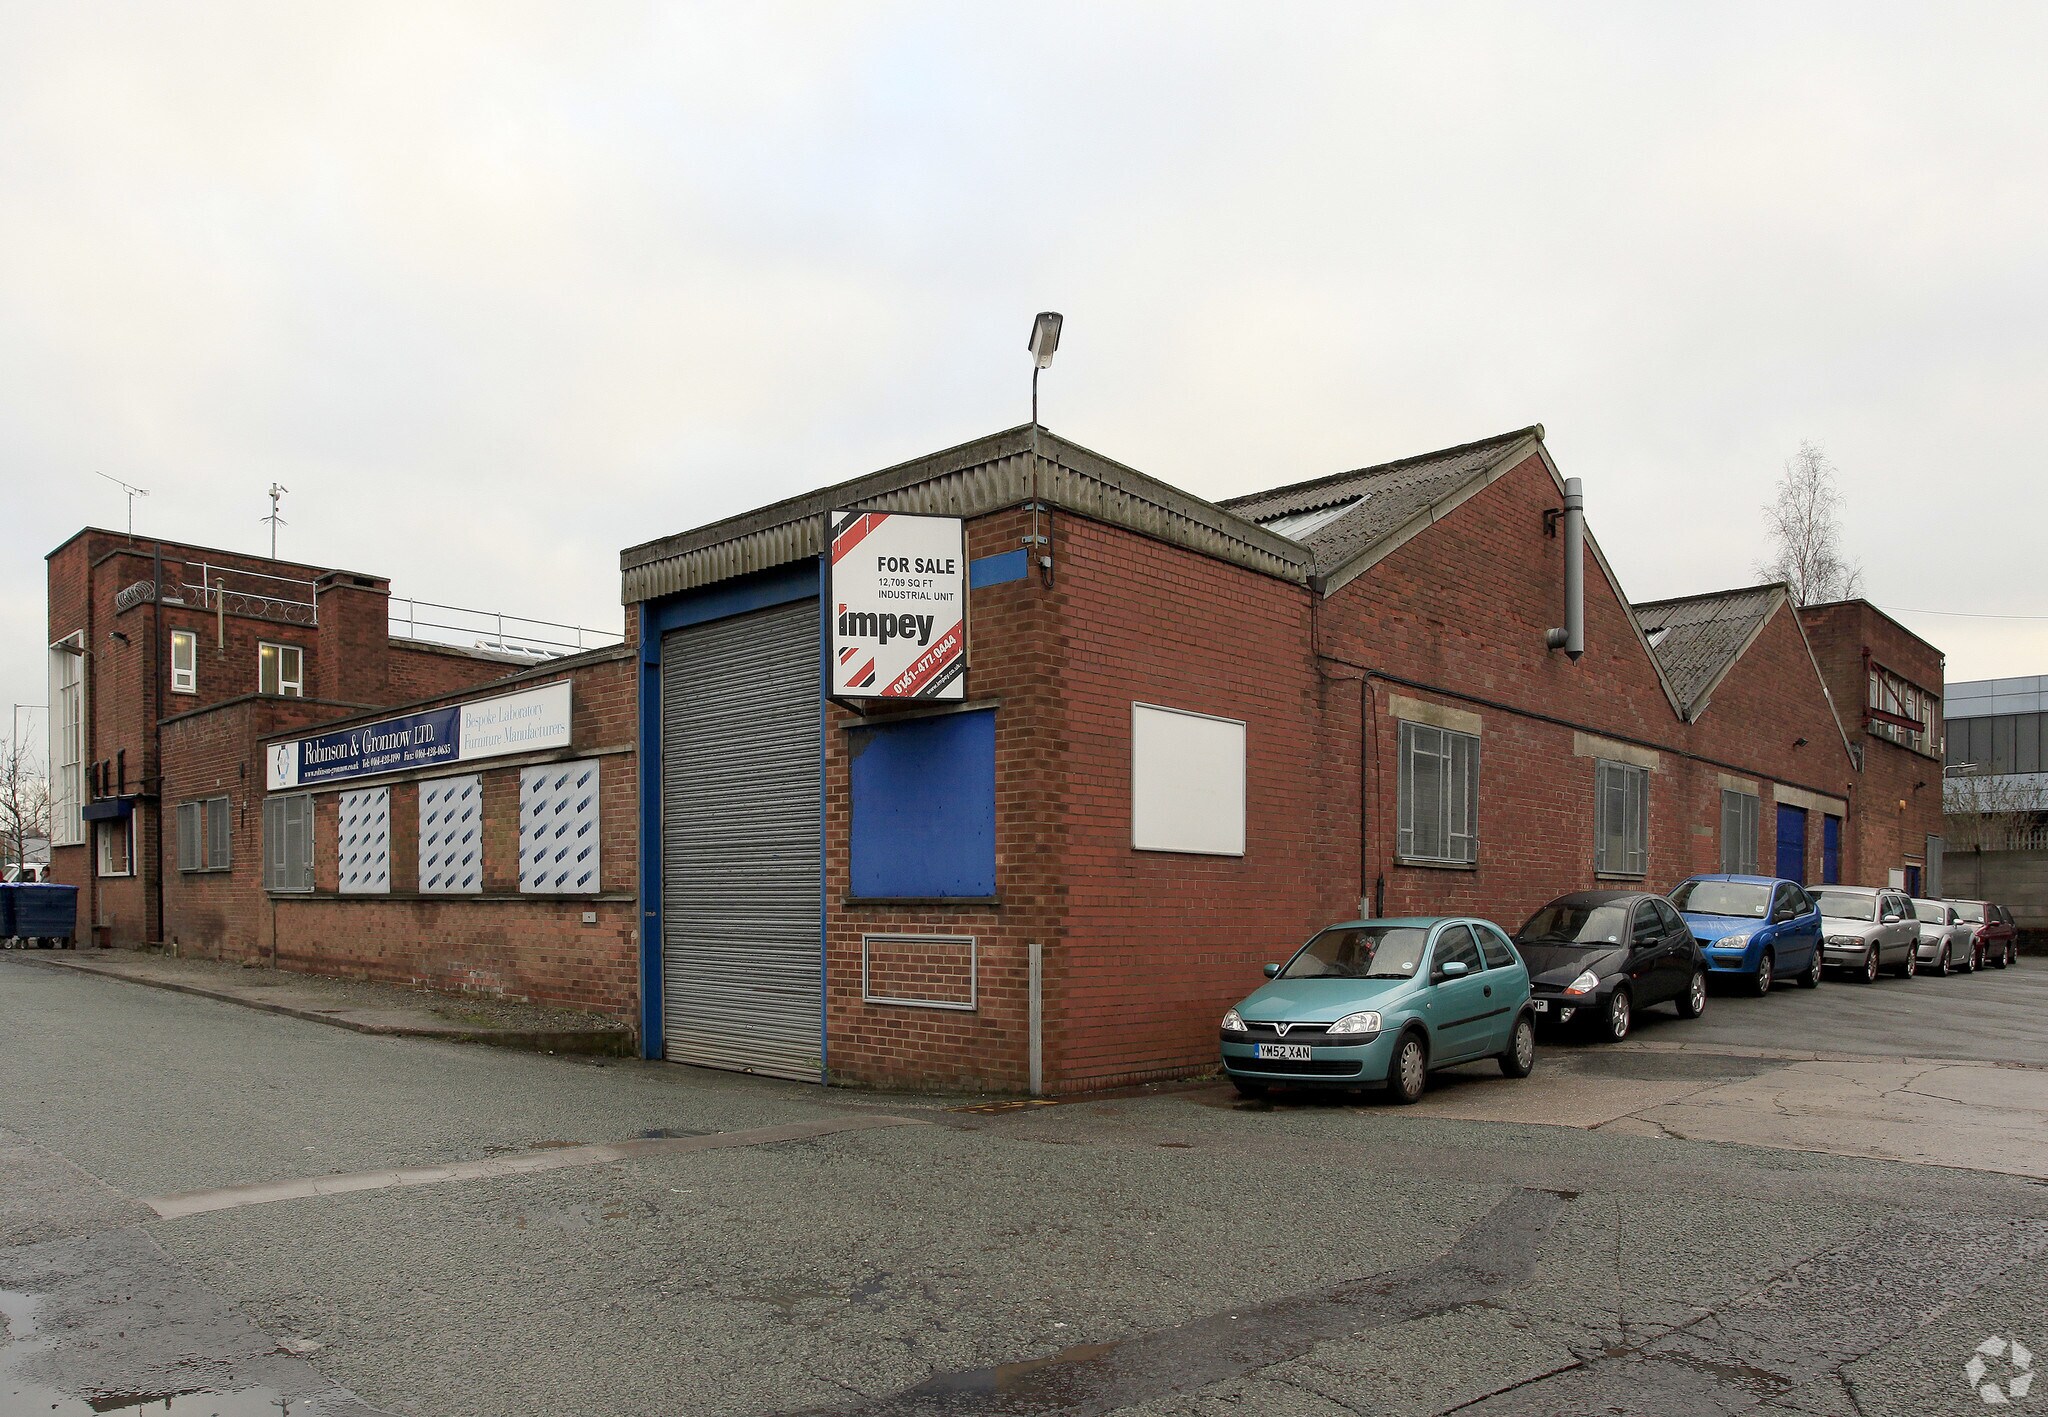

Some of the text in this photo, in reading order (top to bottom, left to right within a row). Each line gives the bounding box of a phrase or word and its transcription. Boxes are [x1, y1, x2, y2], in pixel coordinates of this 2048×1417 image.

[877, 556, 955, 575] FOR SALE
[878, 577, 934, 588] 12,709 SQ FT
[878, 589, 955, 602] INDUSTRIAL UNIT
[838, 603, 935, 647] impey
[465, 703, 544, 733] Bespoke Laboratory
[304, 723, 435, 765] Robinson & Gronnow LTD.
[464, 723, 566, 750] Furniture Manufacturers
[403, 750, 414, 761] Fax:
[1260, 1045, 1310, 1059] YM52 XAN
